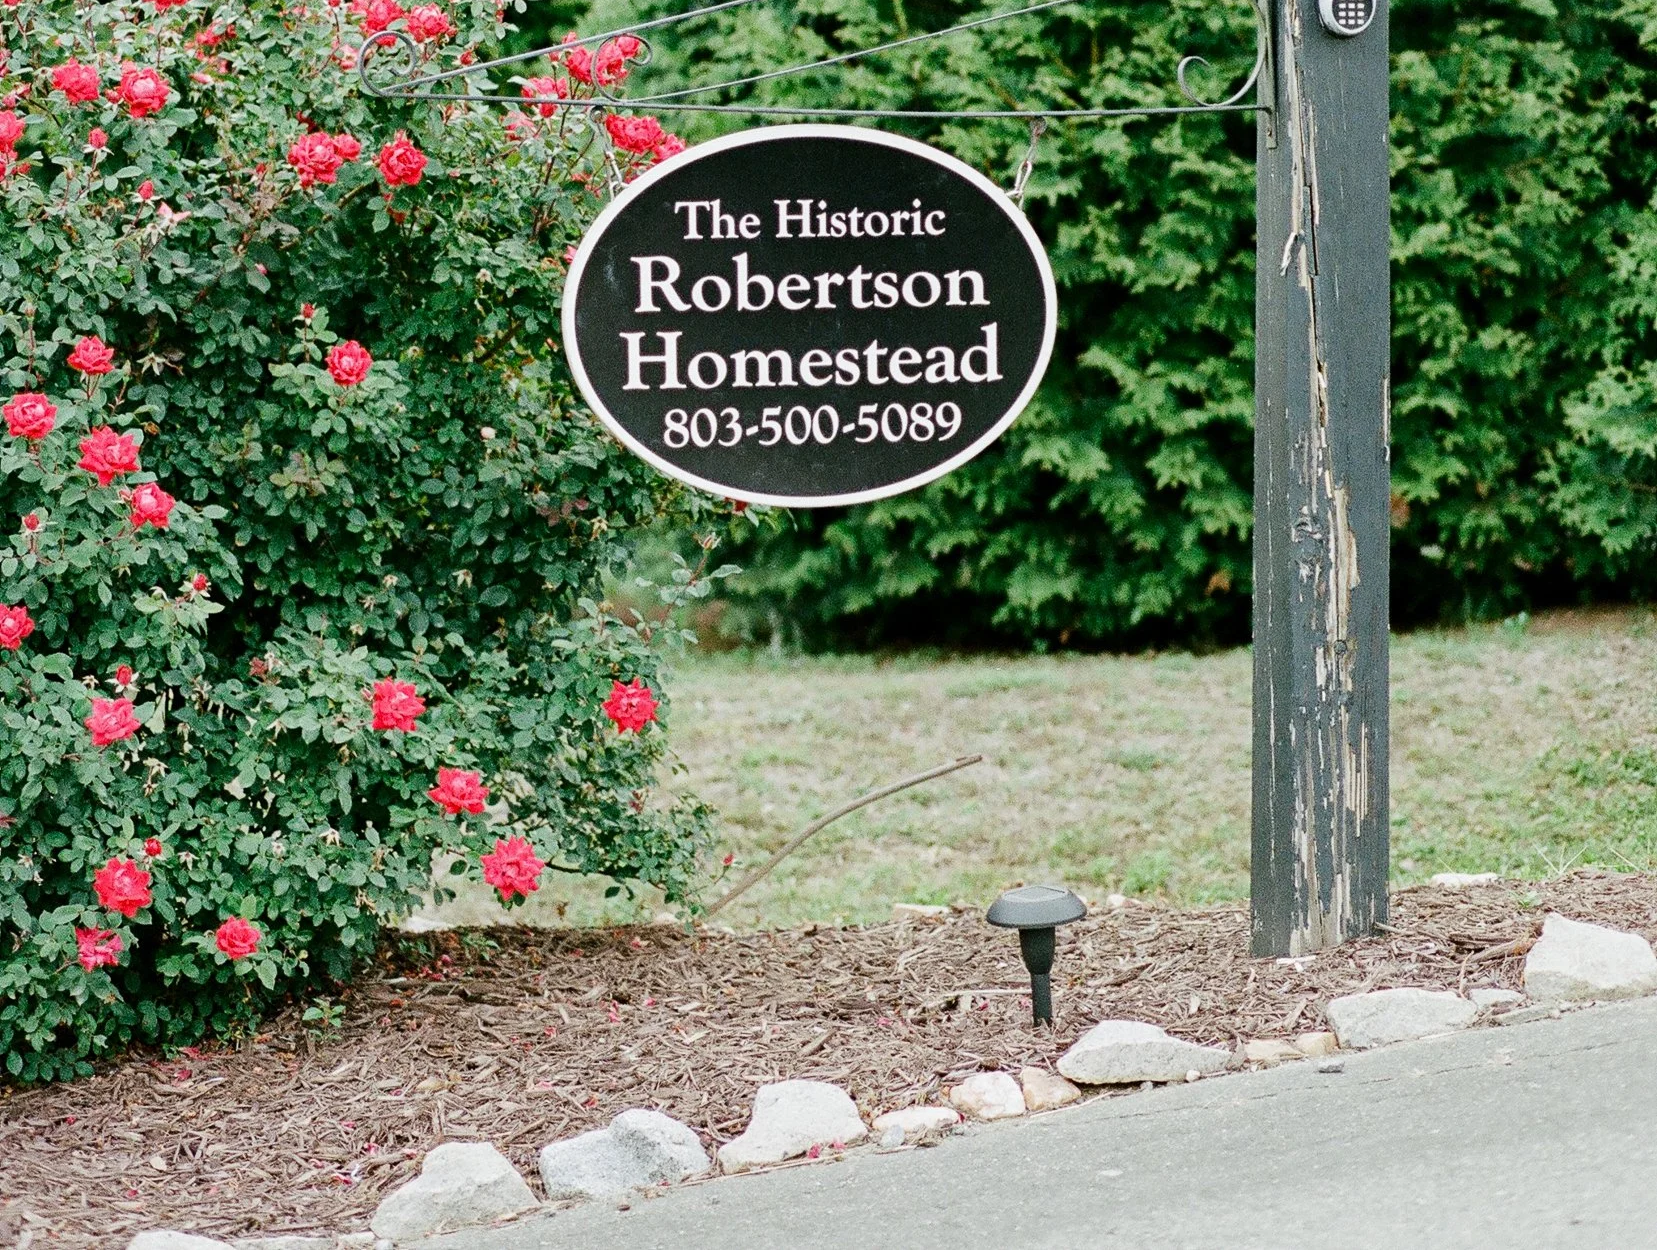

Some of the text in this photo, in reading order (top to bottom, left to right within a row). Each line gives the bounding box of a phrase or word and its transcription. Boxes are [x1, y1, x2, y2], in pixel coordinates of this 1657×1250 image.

[675, 198, 946, 240] The Historic
[629, 252, 991, 313] Robertson
[619, 321, 1004, 391] Homestead
[662, 402, 962, 449] 803-500-5089
